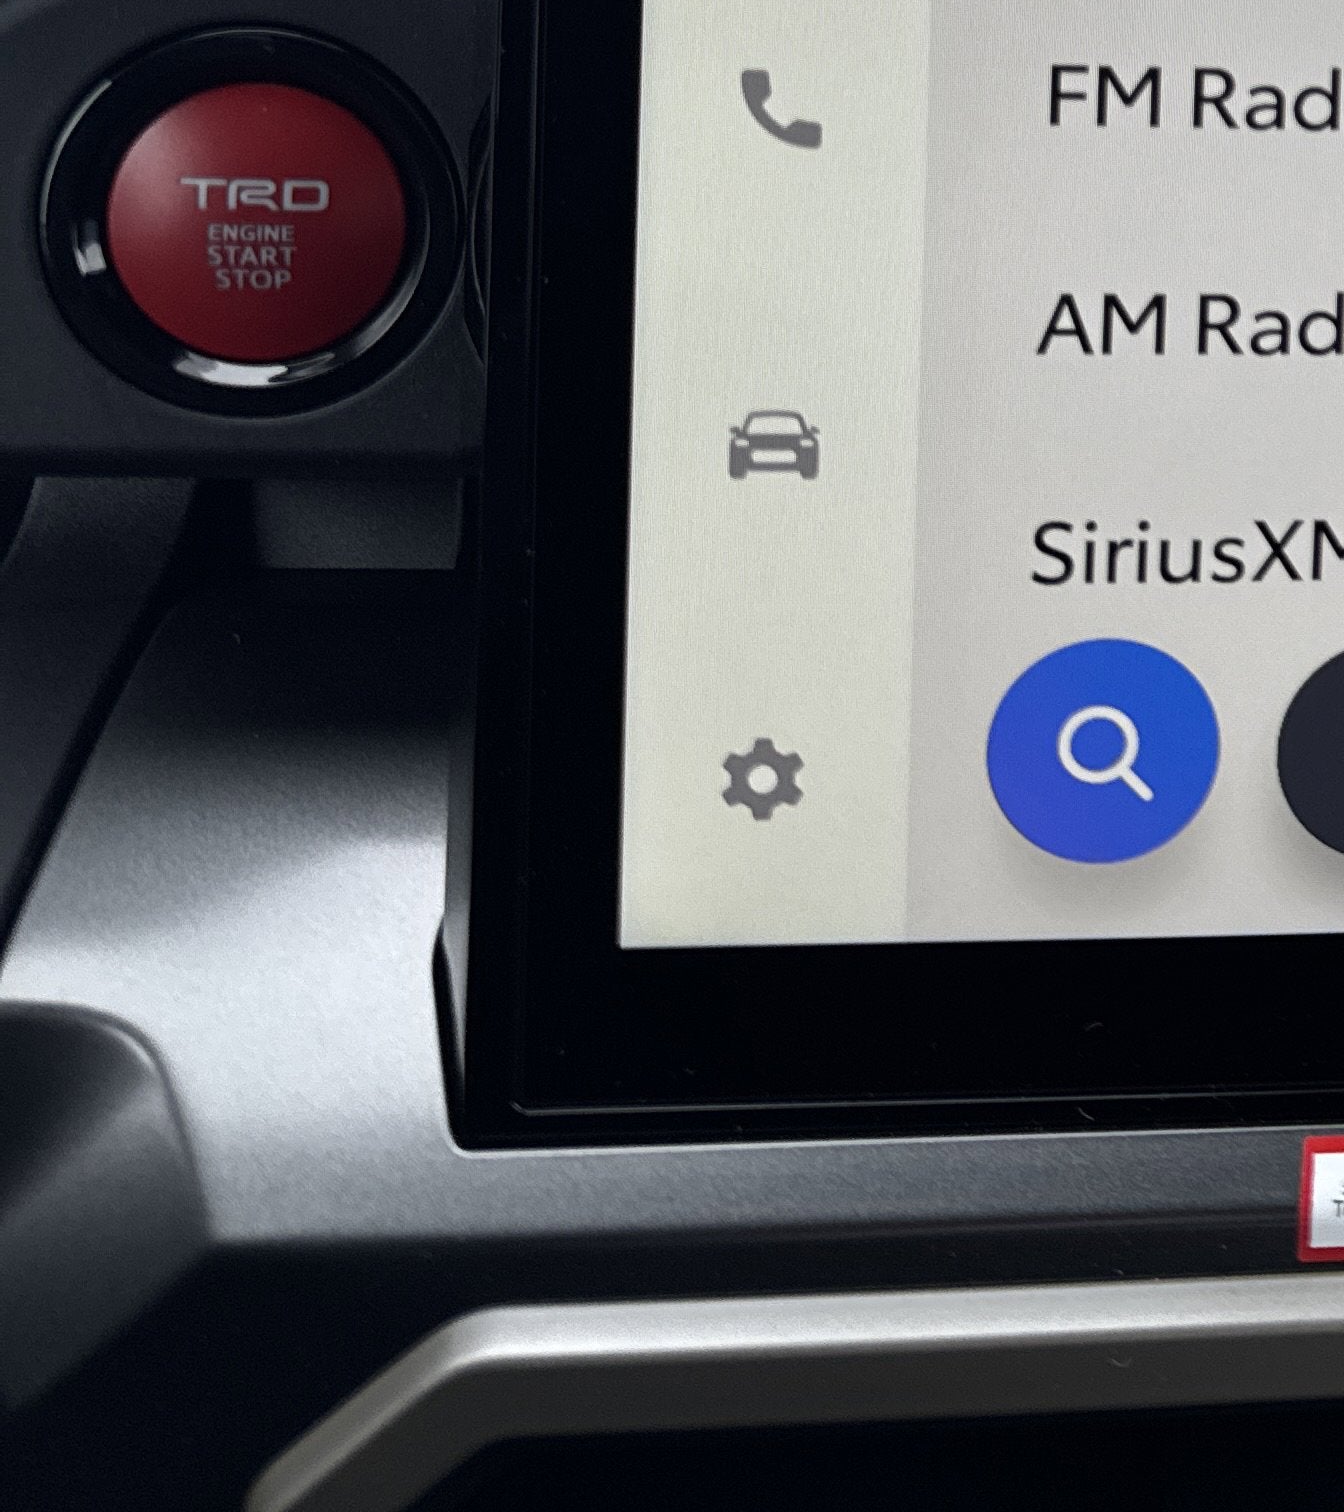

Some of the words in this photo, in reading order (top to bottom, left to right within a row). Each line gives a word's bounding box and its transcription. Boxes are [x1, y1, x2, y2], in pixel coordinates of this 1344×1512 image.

[1050, 64, 1161, 127] FM
[180, 177, 330, 212] TRD
[207, 224, 296, 243] ENGINE
[206, 245, 298, 267] START
[214, 268, 293, 289] STOP
[1037, 294, 1165, 354] AM
